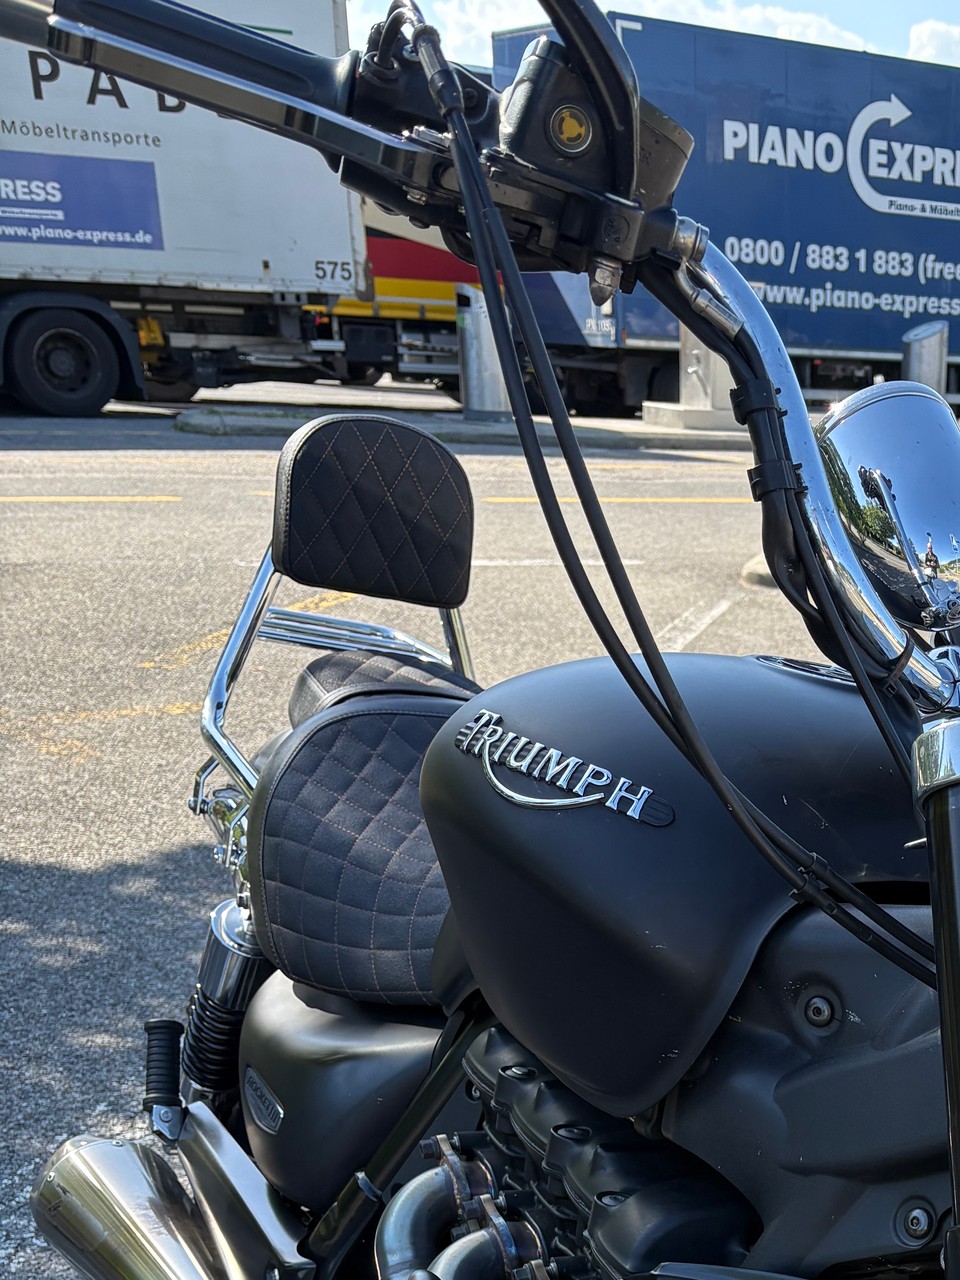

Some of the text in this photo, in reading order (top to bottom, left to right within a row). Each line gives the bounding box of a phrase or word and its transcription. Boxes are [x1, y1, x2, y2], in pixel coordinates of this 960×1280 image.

[0, 119, 162, 147] Möbeltransporte
[723, 119, 844, 173] PIANO
[314, 260, 352, 280] 575
[724, 236, 785, 266] 0800
[789, 241, 801, 274] /
[806, 244, 849, 271] 883
[855, 248, 867, 273] 1
[873, 250, 914, 277] 883
[461, 708, 654, 822] TRIUMPH
[246, 1076, 273, 1111] ROCKET
